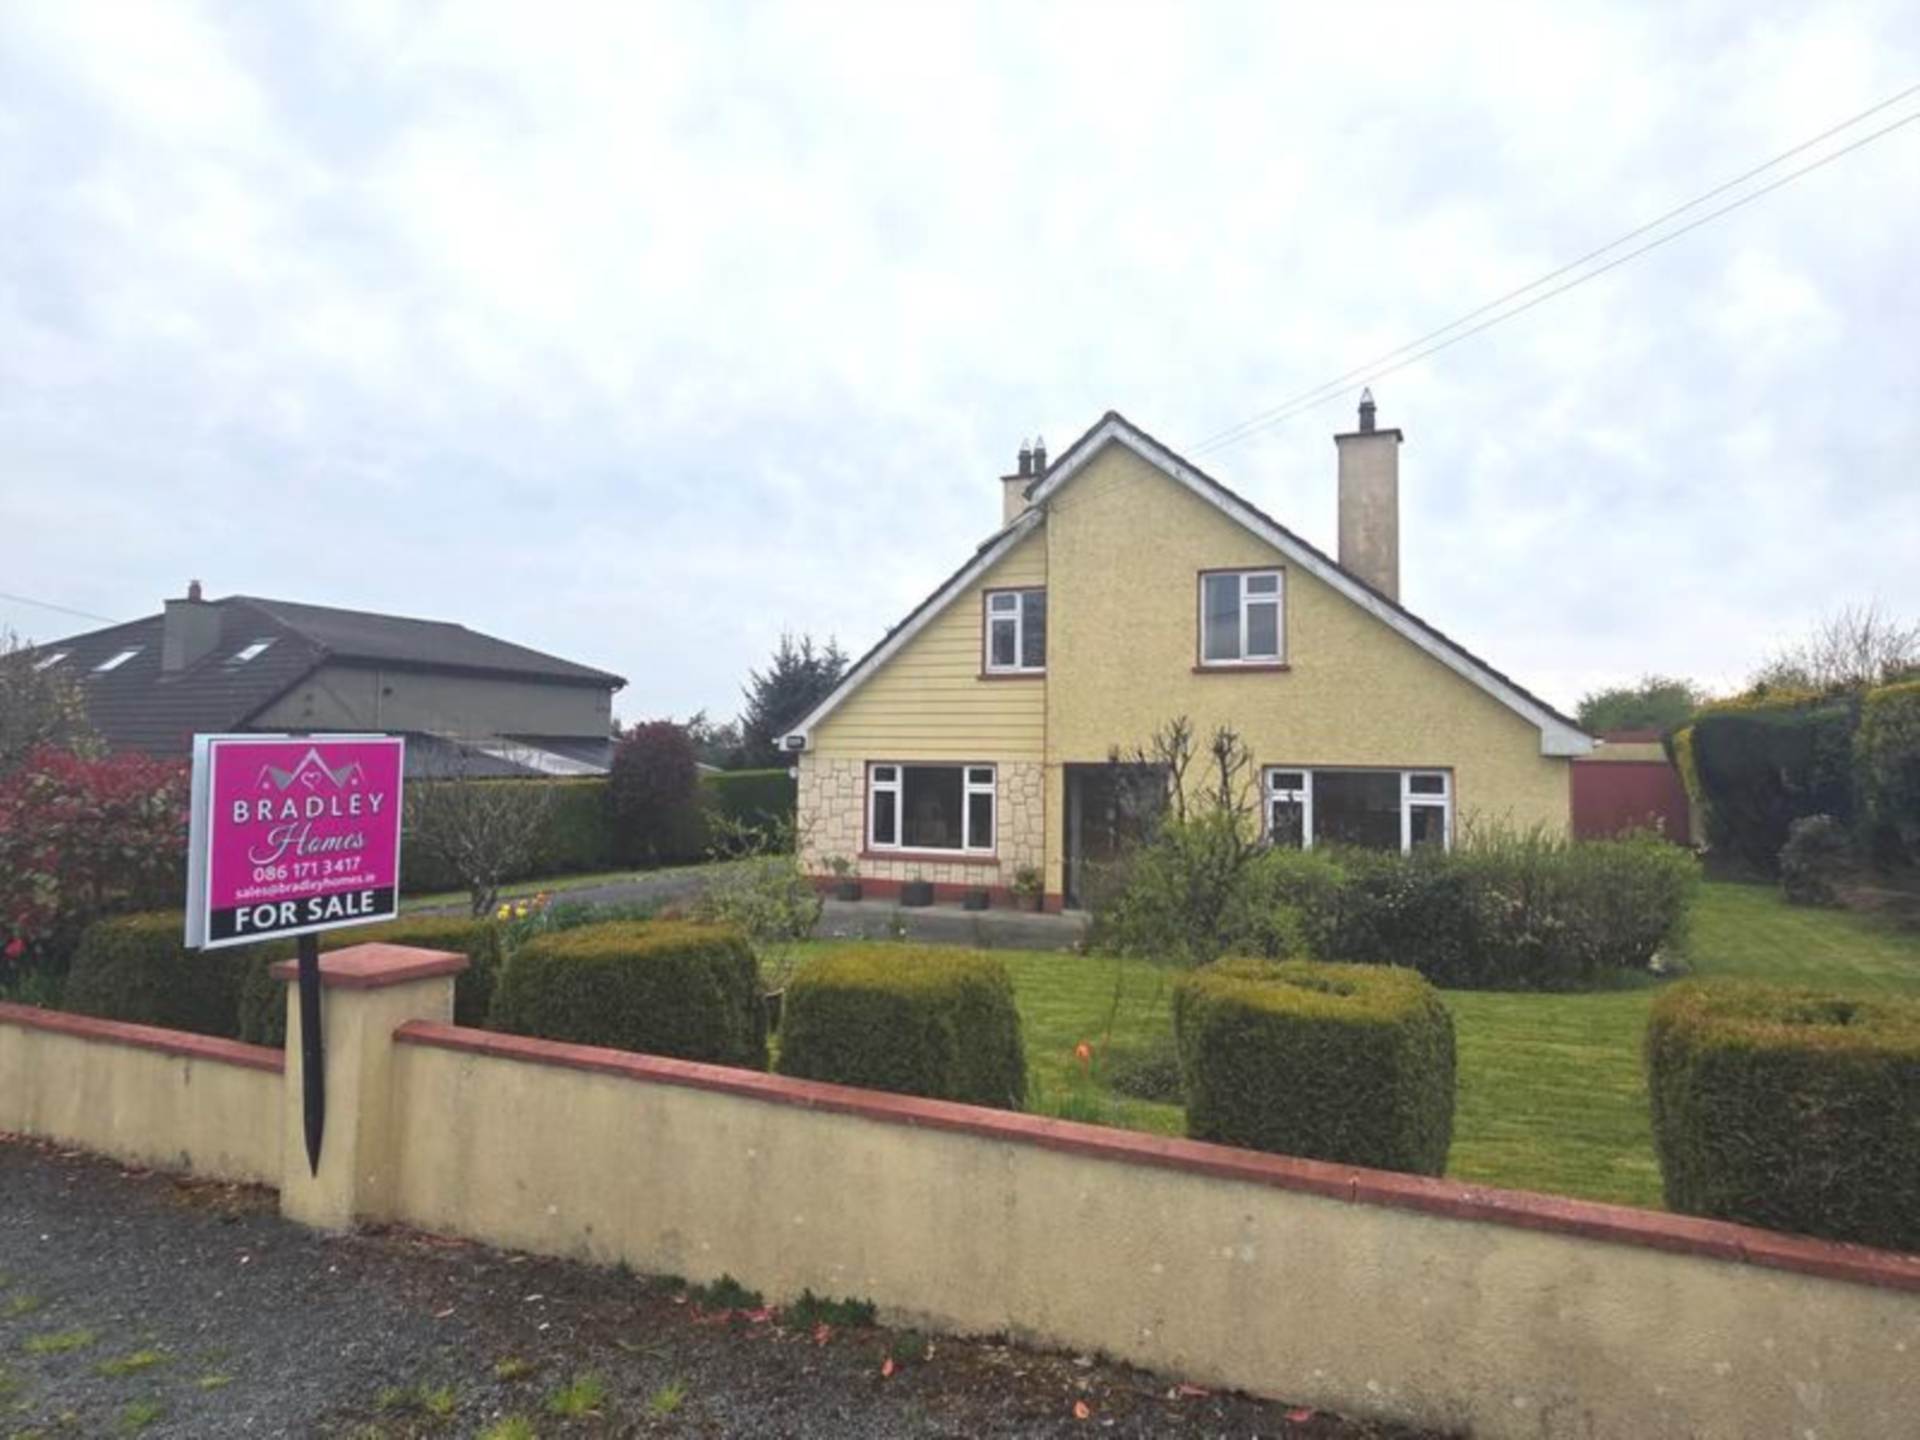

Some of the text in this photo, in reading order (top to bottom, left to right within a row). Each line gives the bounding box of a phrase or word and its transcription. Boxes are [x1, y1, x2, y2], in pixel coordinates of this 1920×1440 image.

[233, 793, 384, 823] BRADLEY
[248, 822, 364, 865] Homes
[253, 857, 361, 882] 086 171 3417
[235, 890, 374, 932] FOR SALE
